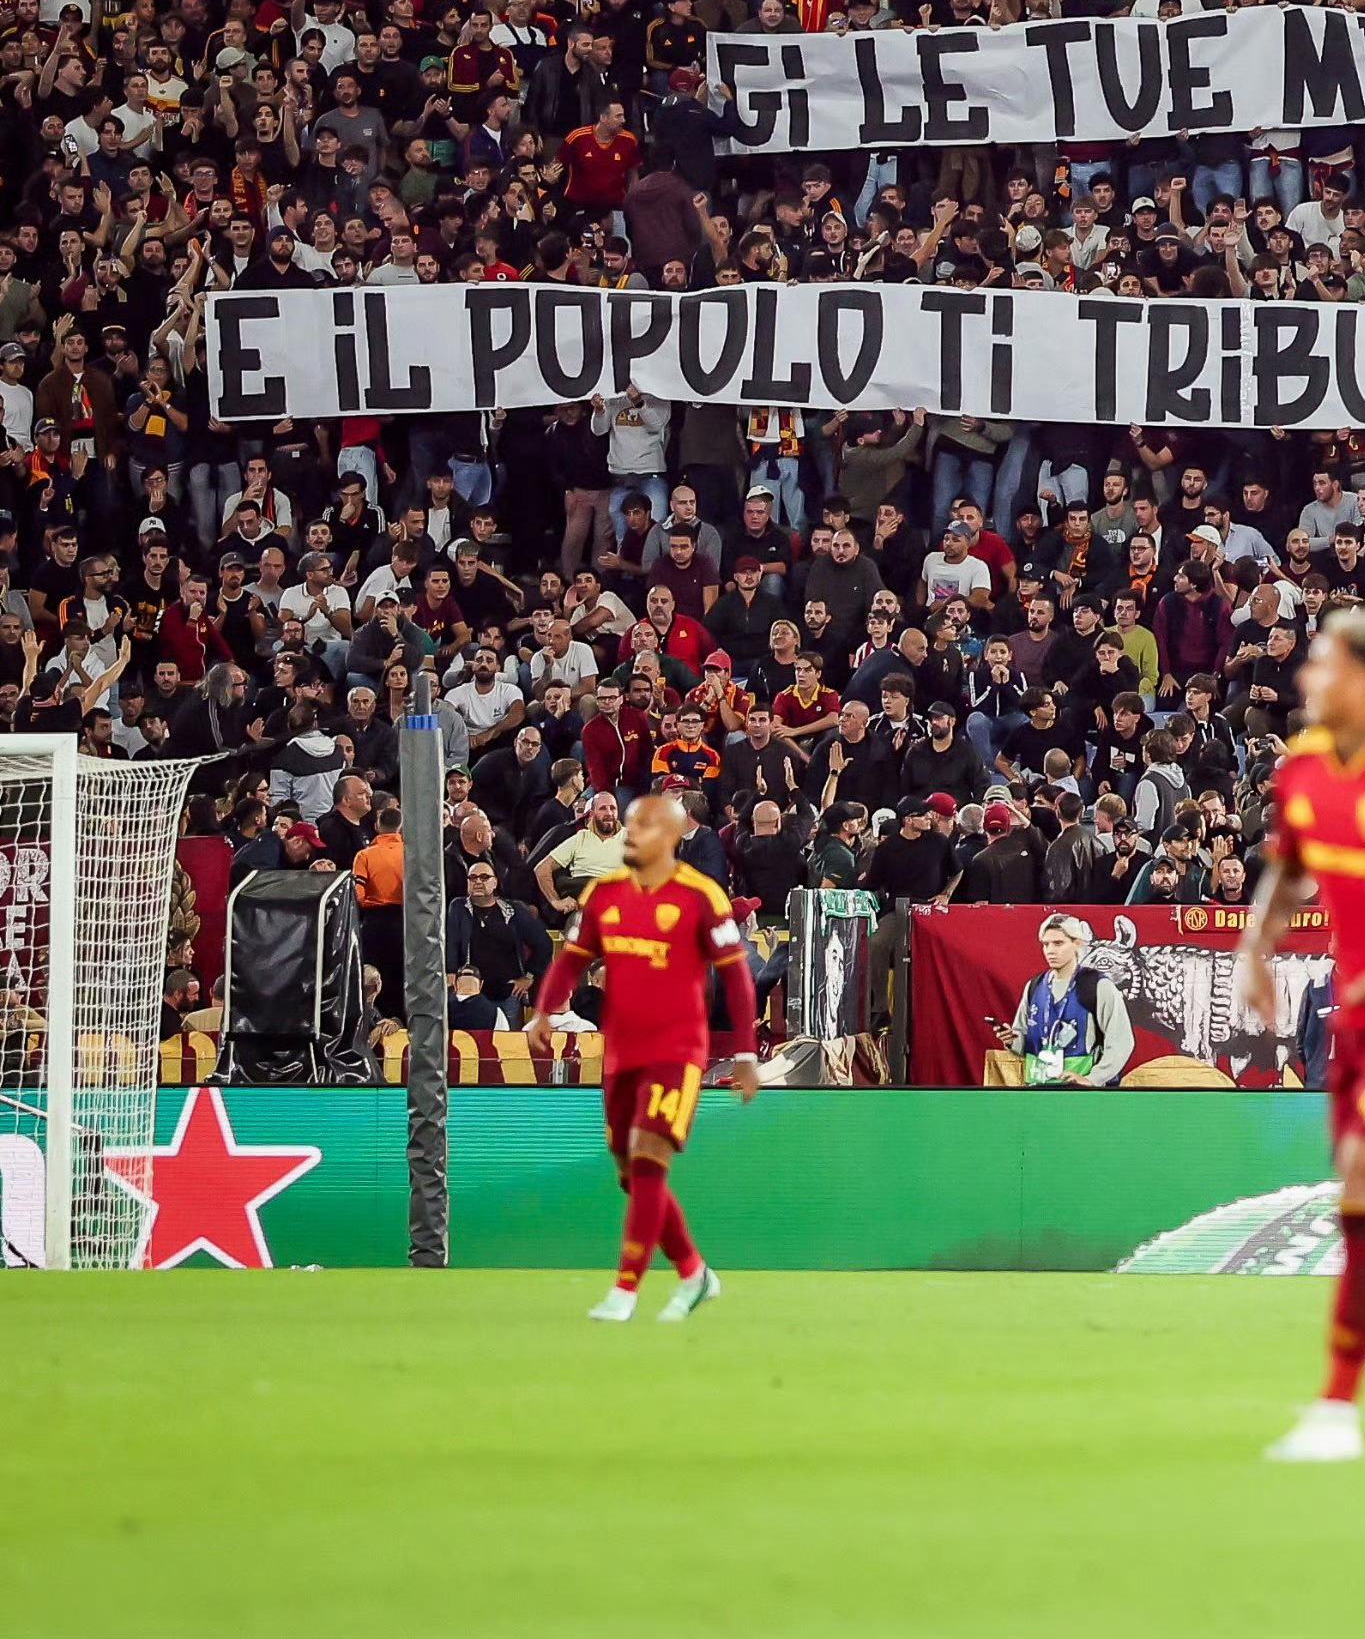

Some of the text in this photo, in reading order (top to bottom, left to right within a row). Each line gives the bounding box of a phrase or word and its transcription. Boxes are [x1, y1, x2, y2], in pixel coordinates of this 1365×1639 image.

[855, 32, 989, 144] LE
[1026, 15, 1234, 137] TUE
[214, 296, 286, 418] E
[465, 288, 883, 408] POPOLO
